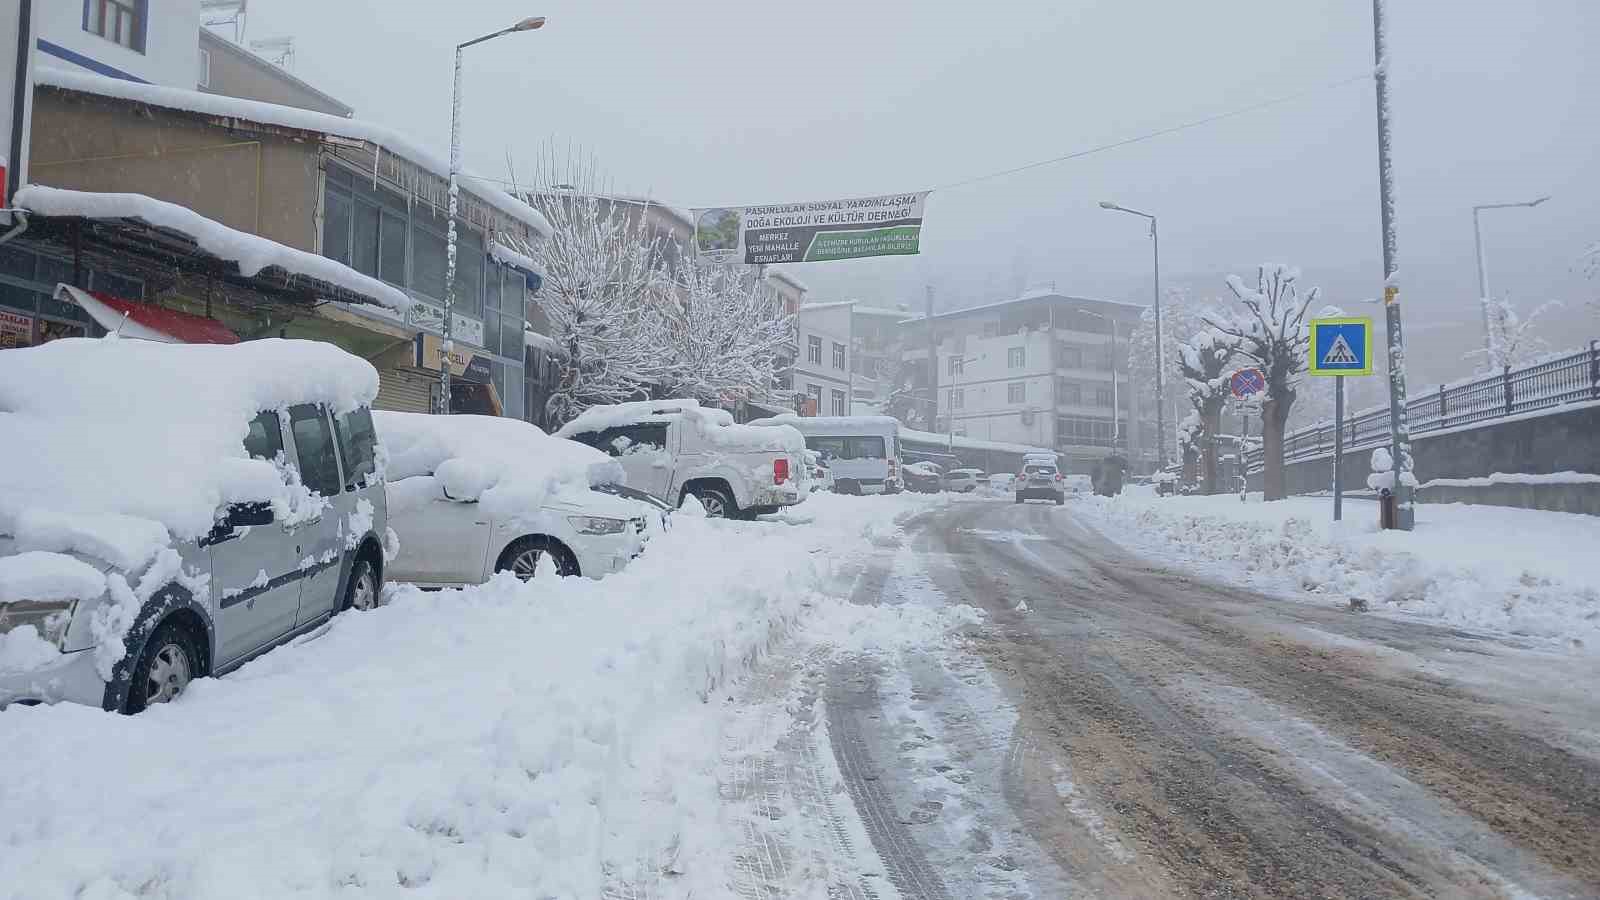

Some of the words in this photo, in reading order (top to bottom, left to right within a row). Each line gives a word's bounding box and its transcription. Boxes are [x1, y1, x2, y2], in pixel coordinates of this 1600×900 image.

[747, 217, 770, 229] DOĞA
[813, 214, 825, 224] VE
[828, 210, 864, 223] KÜLTÜR
[759, 232, 789, 241] MERKEZ
[764, 241, 799, 252] MAHALLE
